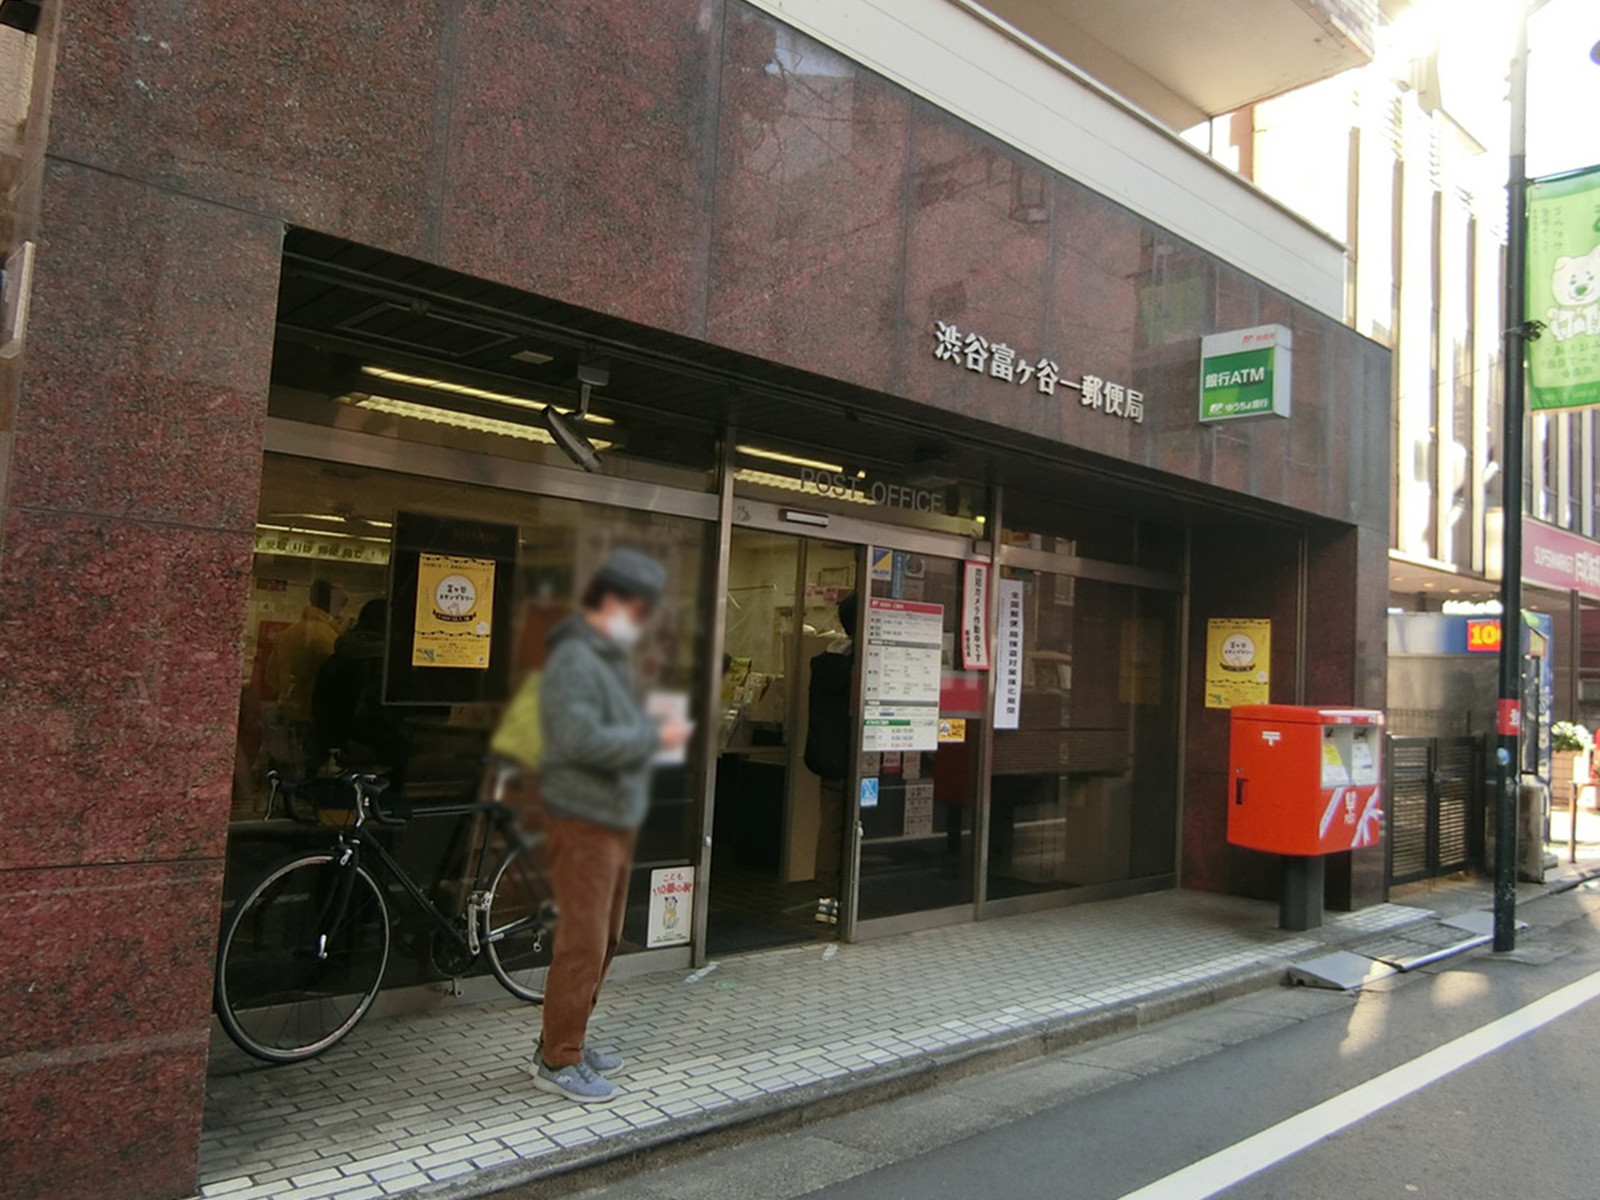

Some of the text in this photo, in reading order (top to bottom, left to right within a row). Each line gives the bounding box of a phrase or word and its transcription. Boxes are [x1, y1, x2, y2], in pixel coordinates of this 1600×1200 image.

[934, 320, 1144, 424] 渋谷富ヶ谷一郵便局
[1205, 366, 1266, 389] 銀行ATM
[800, 467, 943, 513] POST OFFICE
[1470, 623, 1502, 646] 10
[652, 882, 693, 896] 110番の家
[663, 873, 684, 883] こども
